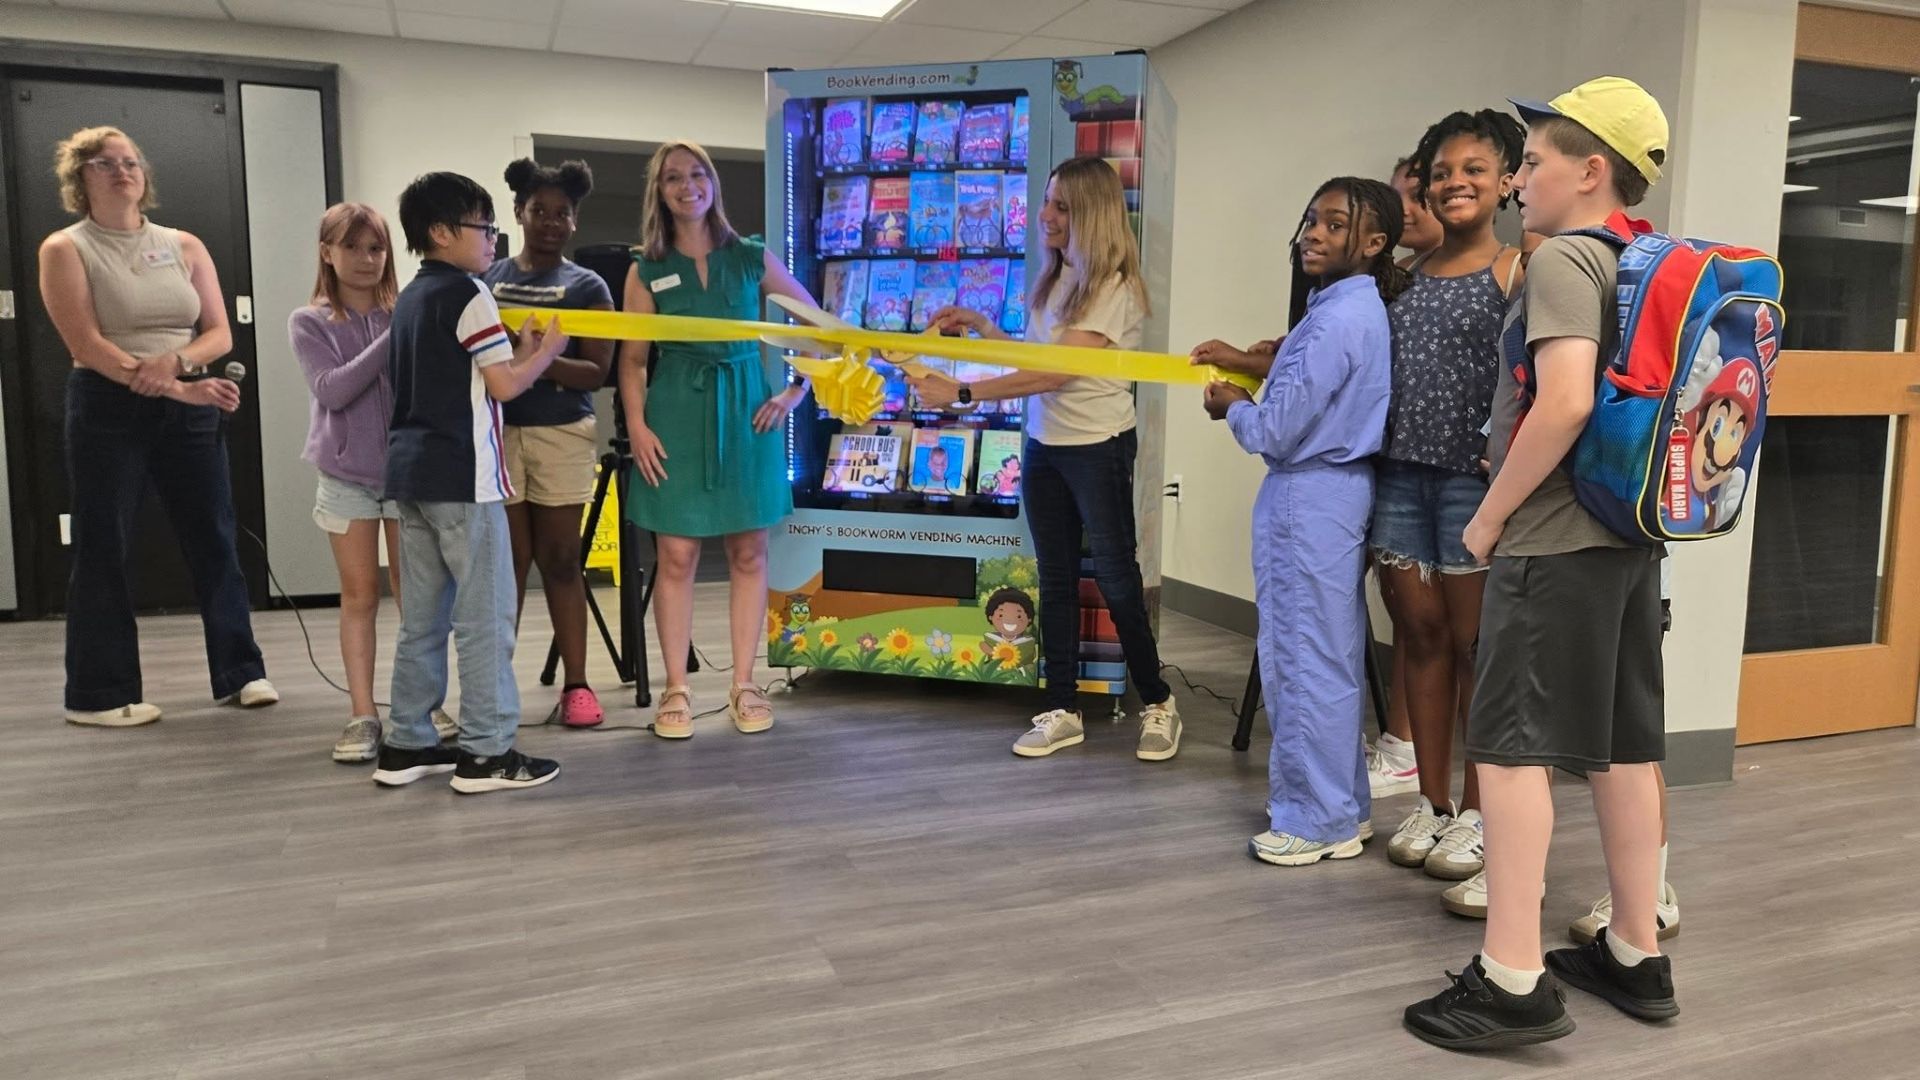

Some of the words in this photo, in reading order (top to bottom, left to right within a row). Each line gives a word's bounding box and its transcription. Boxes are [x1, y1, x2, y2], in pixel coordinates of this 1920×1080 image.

[827, 73, 951, 88] BookVending.com
[843, 435, 876, 451] SCHOOL
[877, 437, 896, 453] BUS
[1670, 444, 1686, 481] SUPER
[1671, 483, 1687, 519] MARIO
[788, 524, 833, 536] INCHY'S
[837, 526, 907, 540] BOOKWORM
[910, 531, 962, 543] VENDING
[966, 534, 1021, 547] MACHINE
